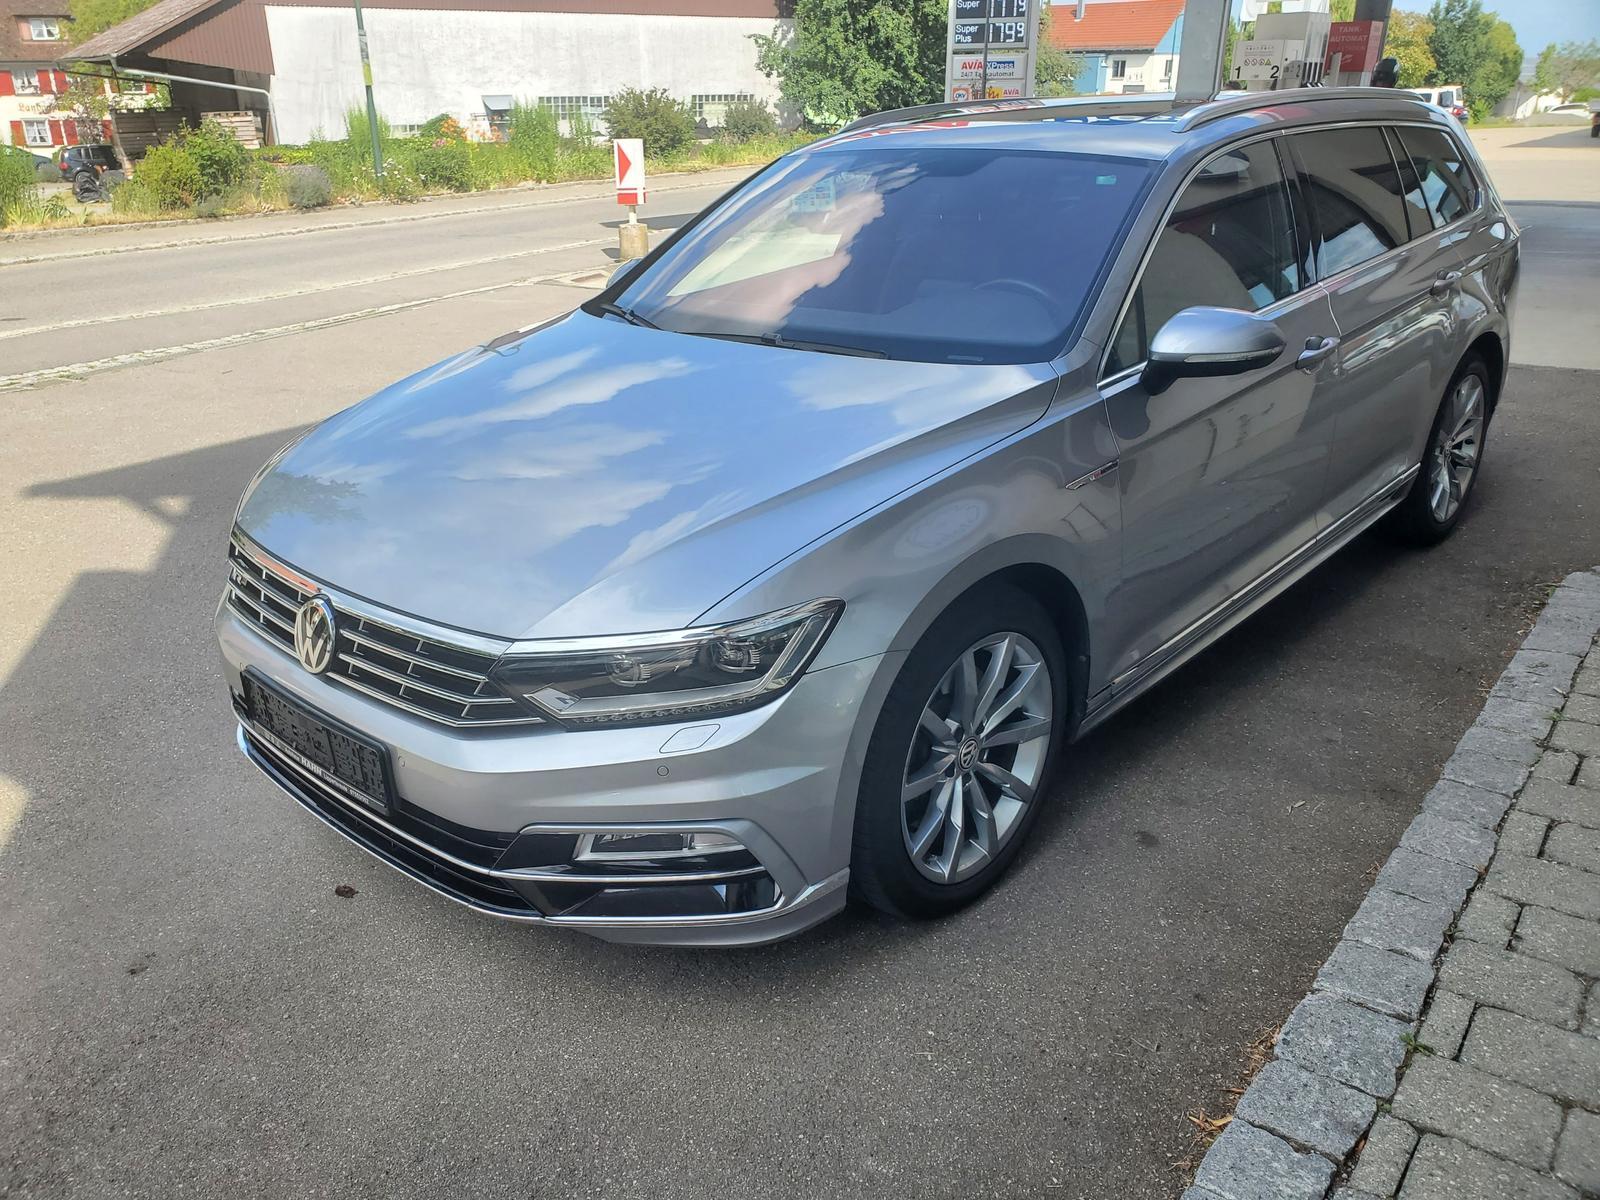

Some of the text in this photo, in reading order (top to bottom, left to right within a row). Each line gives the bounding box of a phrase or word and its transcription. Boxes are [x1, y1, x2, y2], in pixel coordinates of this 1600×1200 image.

[957, 0, 979, 10] Super
[955, 25, 979, 34] Super
[955, 35, 972, 43] Plus
[961, 59, 984, 70] AVIA
[1235, 66, 1241, 79] 1
[1270, 65, 1280, 79] 2
